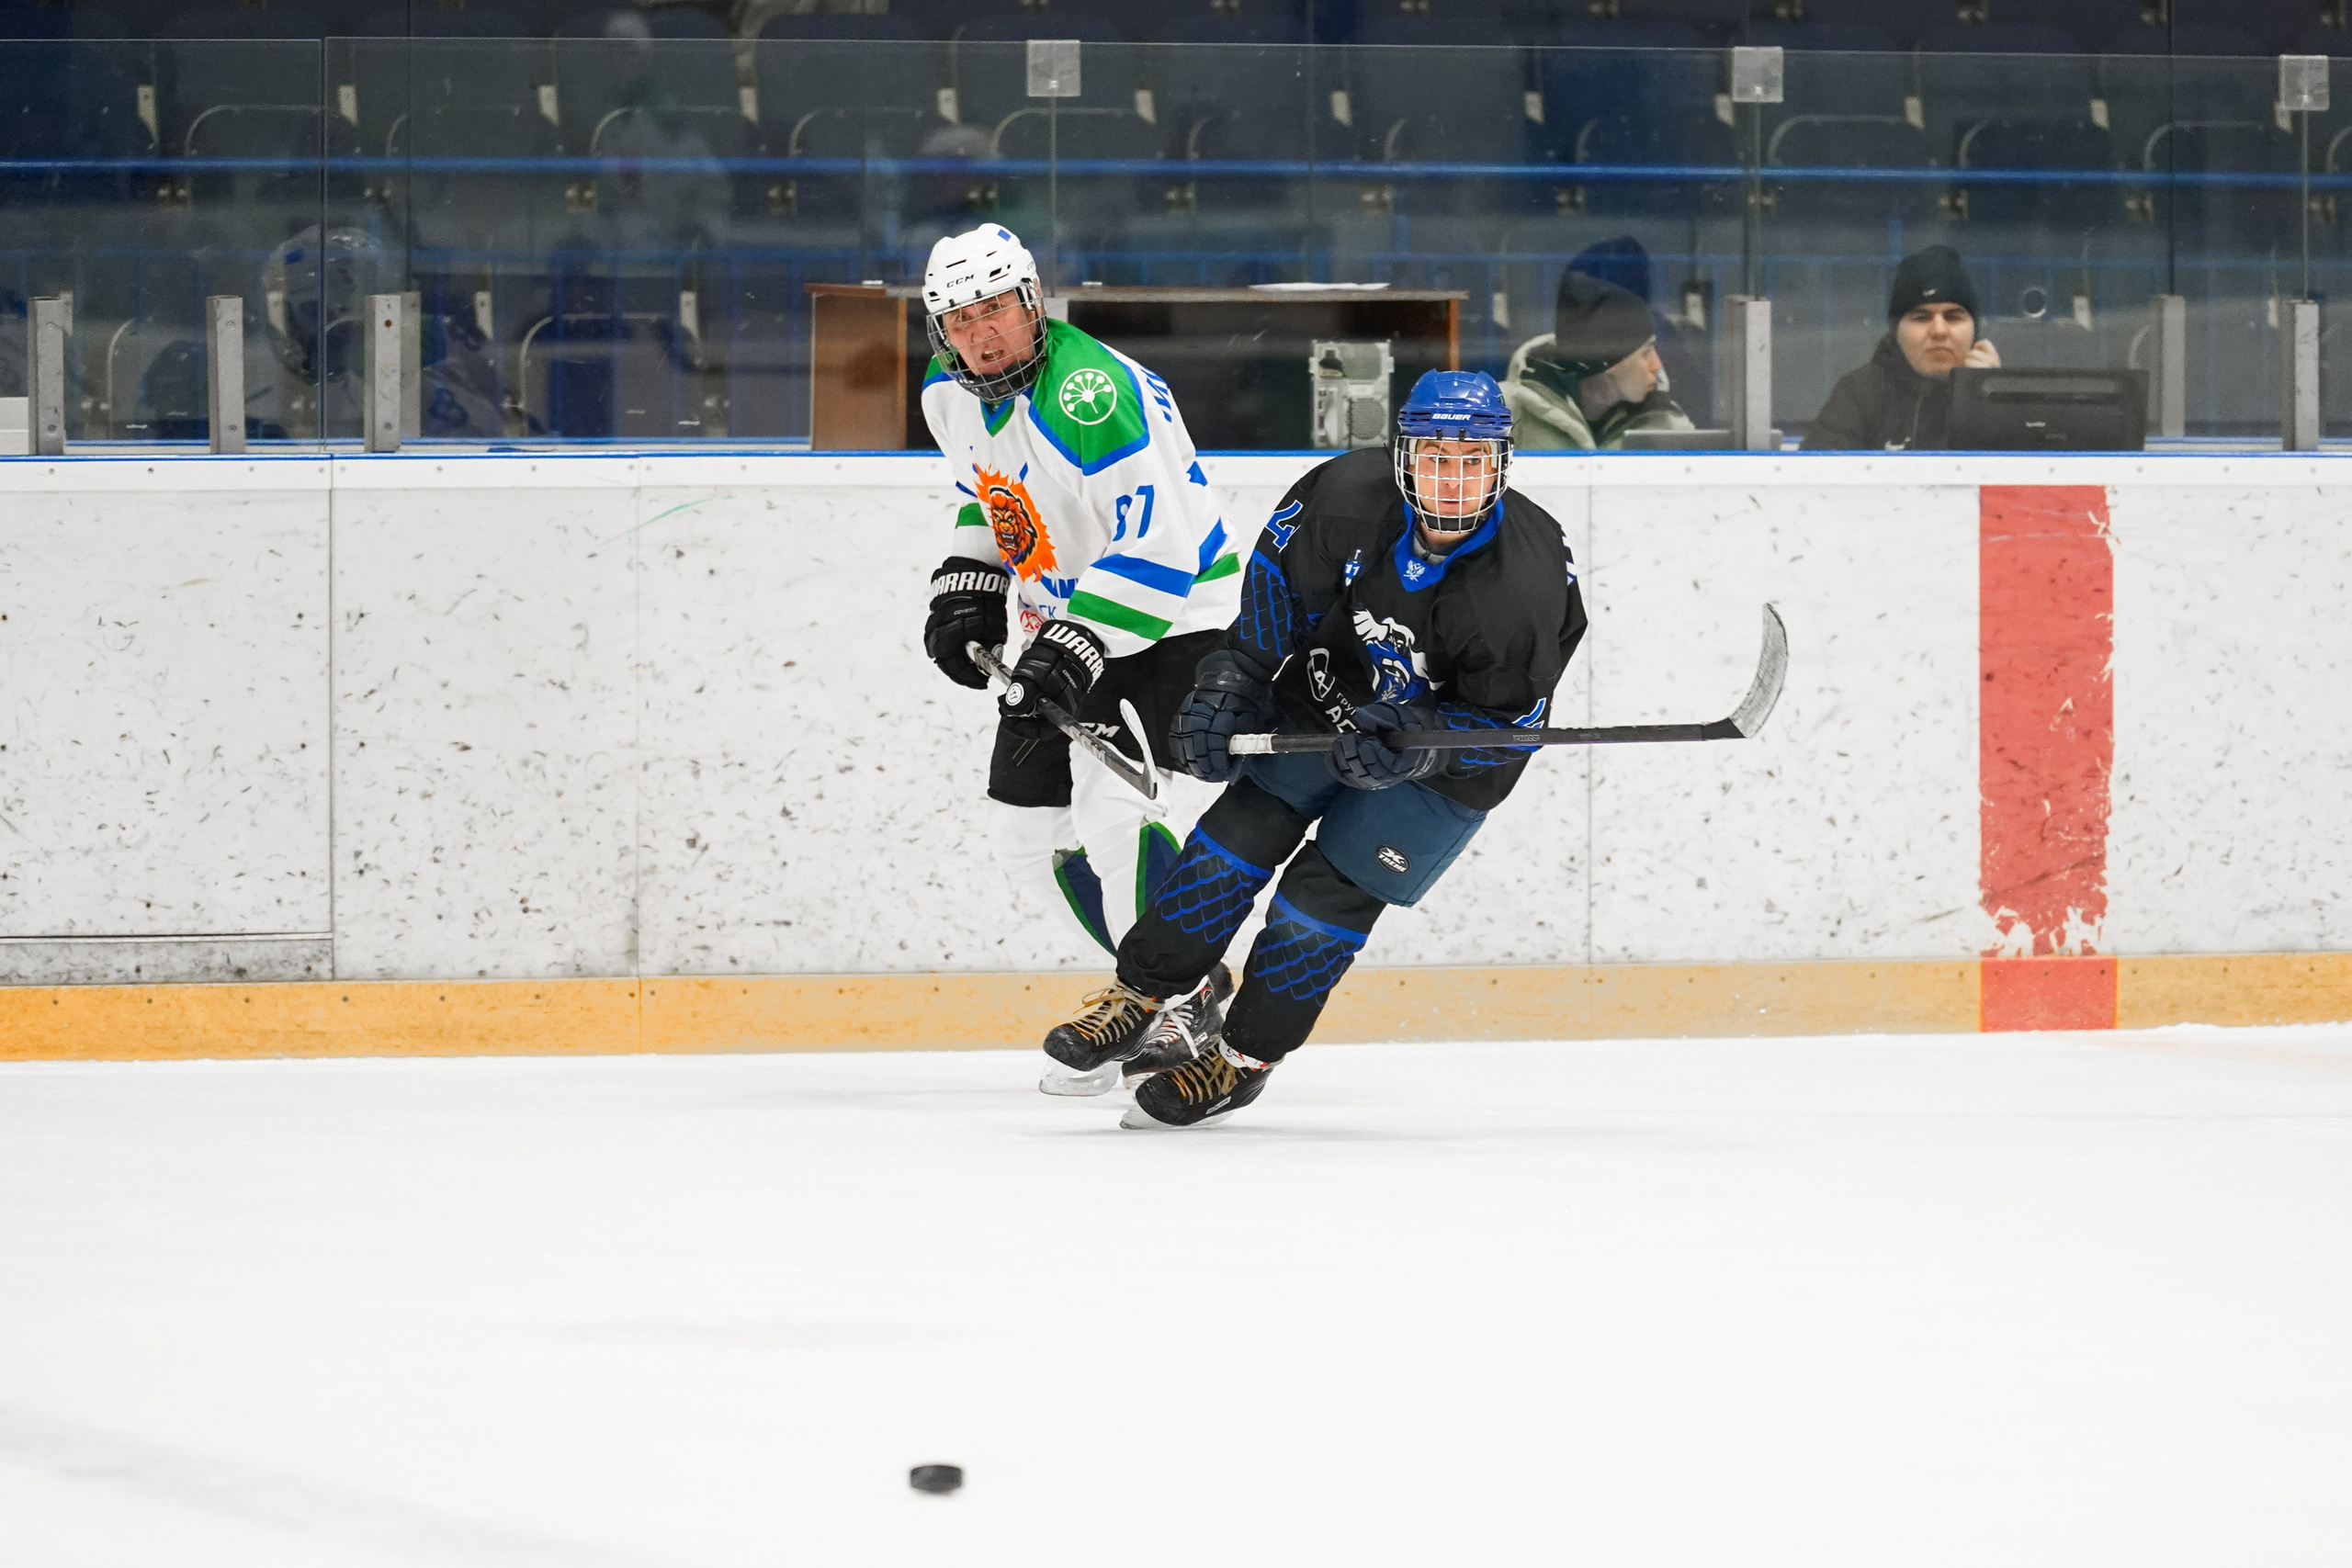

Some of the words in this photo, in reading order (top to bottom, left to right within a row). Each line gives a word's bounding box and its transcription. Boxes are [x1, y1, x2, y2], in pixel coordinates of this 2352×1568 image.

[946, 274, 975, 288] CCM
[1431, 412, 1472, 421] BAUER
[1264, 499, 1304, 554] 4
[1043, 623, 1105, 682] WARR
[1061, 669, 1078, 689] COVERT
[1325, 705, 1362, 734] АС
[1512, 734, 1541, 742] TRIGGER
